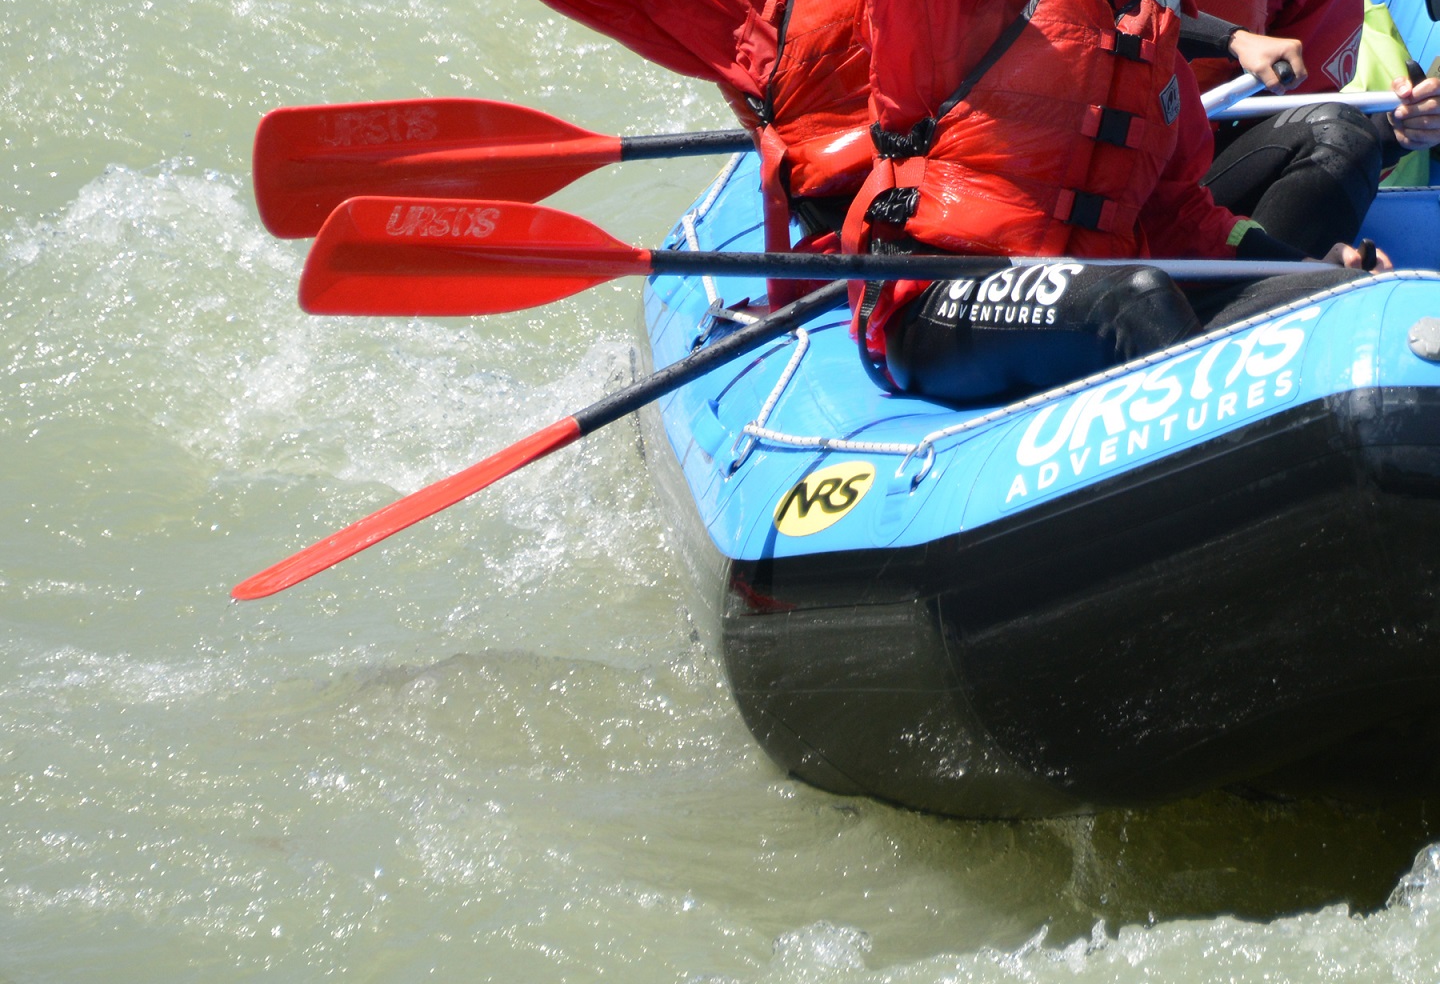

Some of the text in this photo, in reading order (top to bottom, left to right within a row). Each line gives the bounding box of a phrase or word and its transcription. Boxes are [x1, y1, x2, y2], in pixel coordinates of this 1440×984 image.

[937, 301, 1056, 325] ADVENTURES
[1005, 370, 1293, 503] ADVENTURES
[777, 473, 871, 519] NRS
